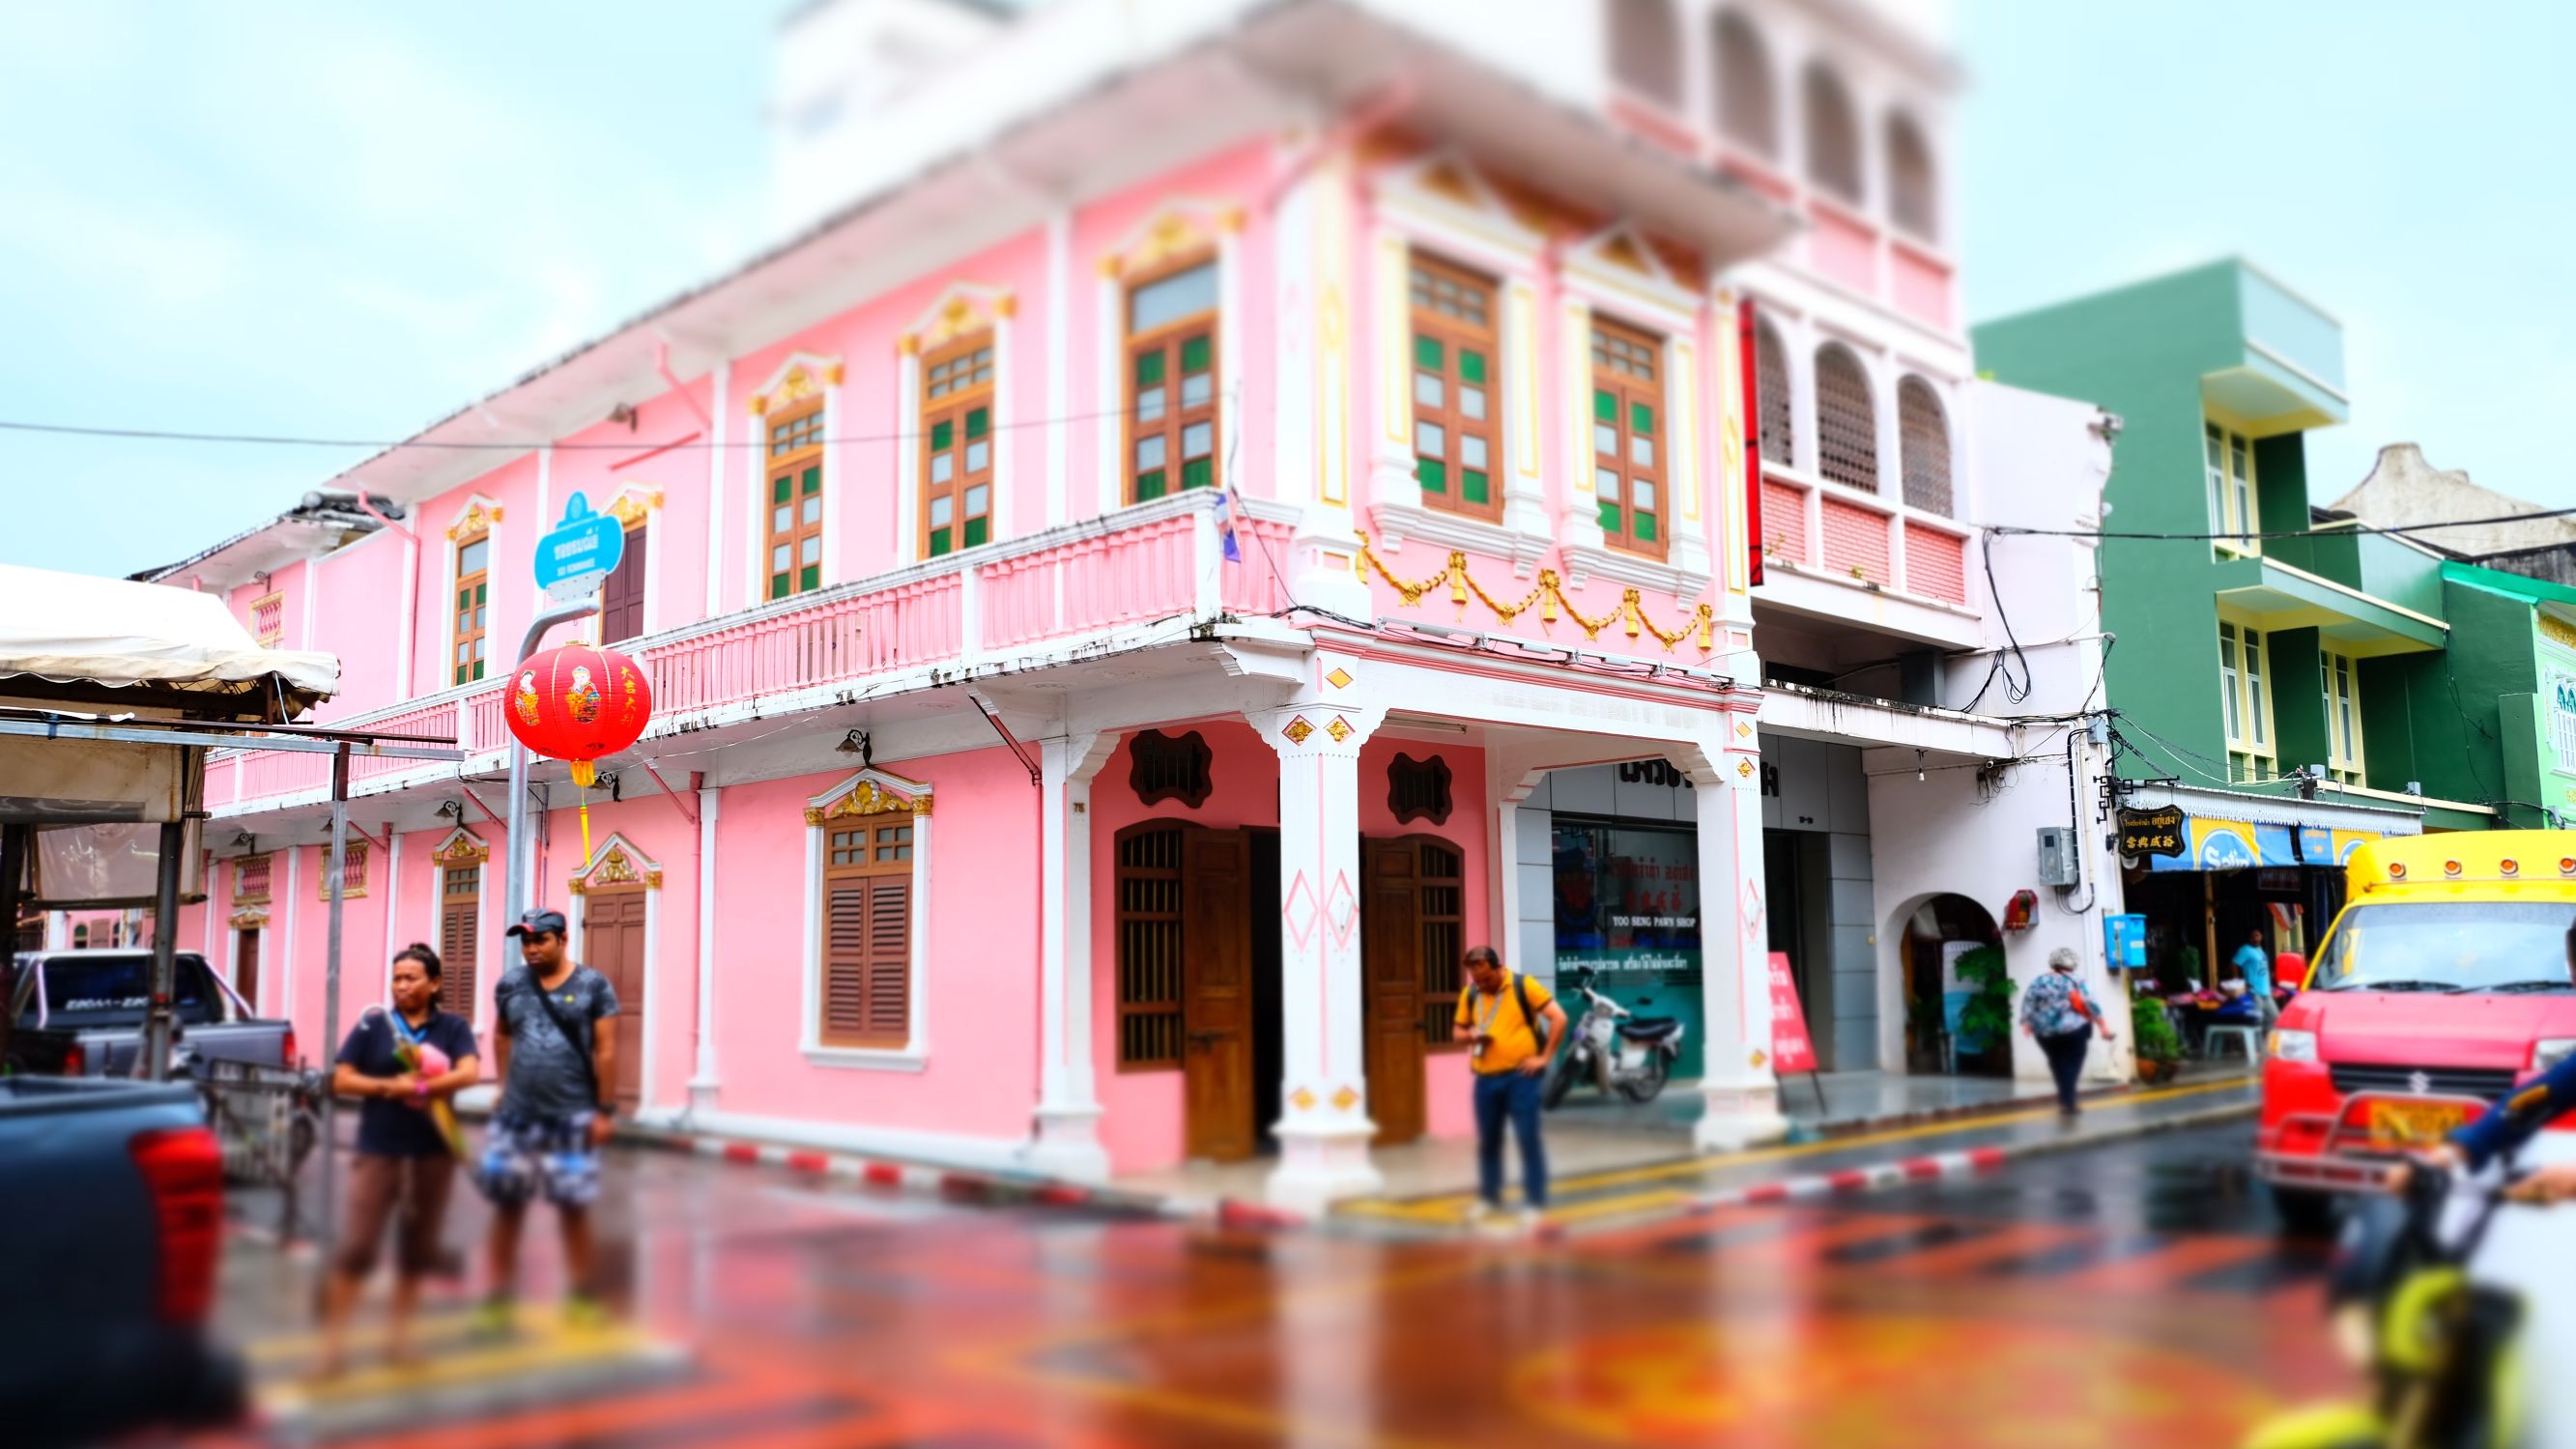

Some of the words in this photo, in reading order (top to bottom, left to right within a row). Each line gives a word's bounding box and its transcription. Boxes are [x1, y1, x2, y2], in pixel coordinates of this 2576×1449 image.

[1613, 916, 1629, 926] YOO
[1631, 916, 1651, 927] SENG
[1653, 917, 1674, 927] PAWN
[1676, 917, 1696, 927] SHOP
